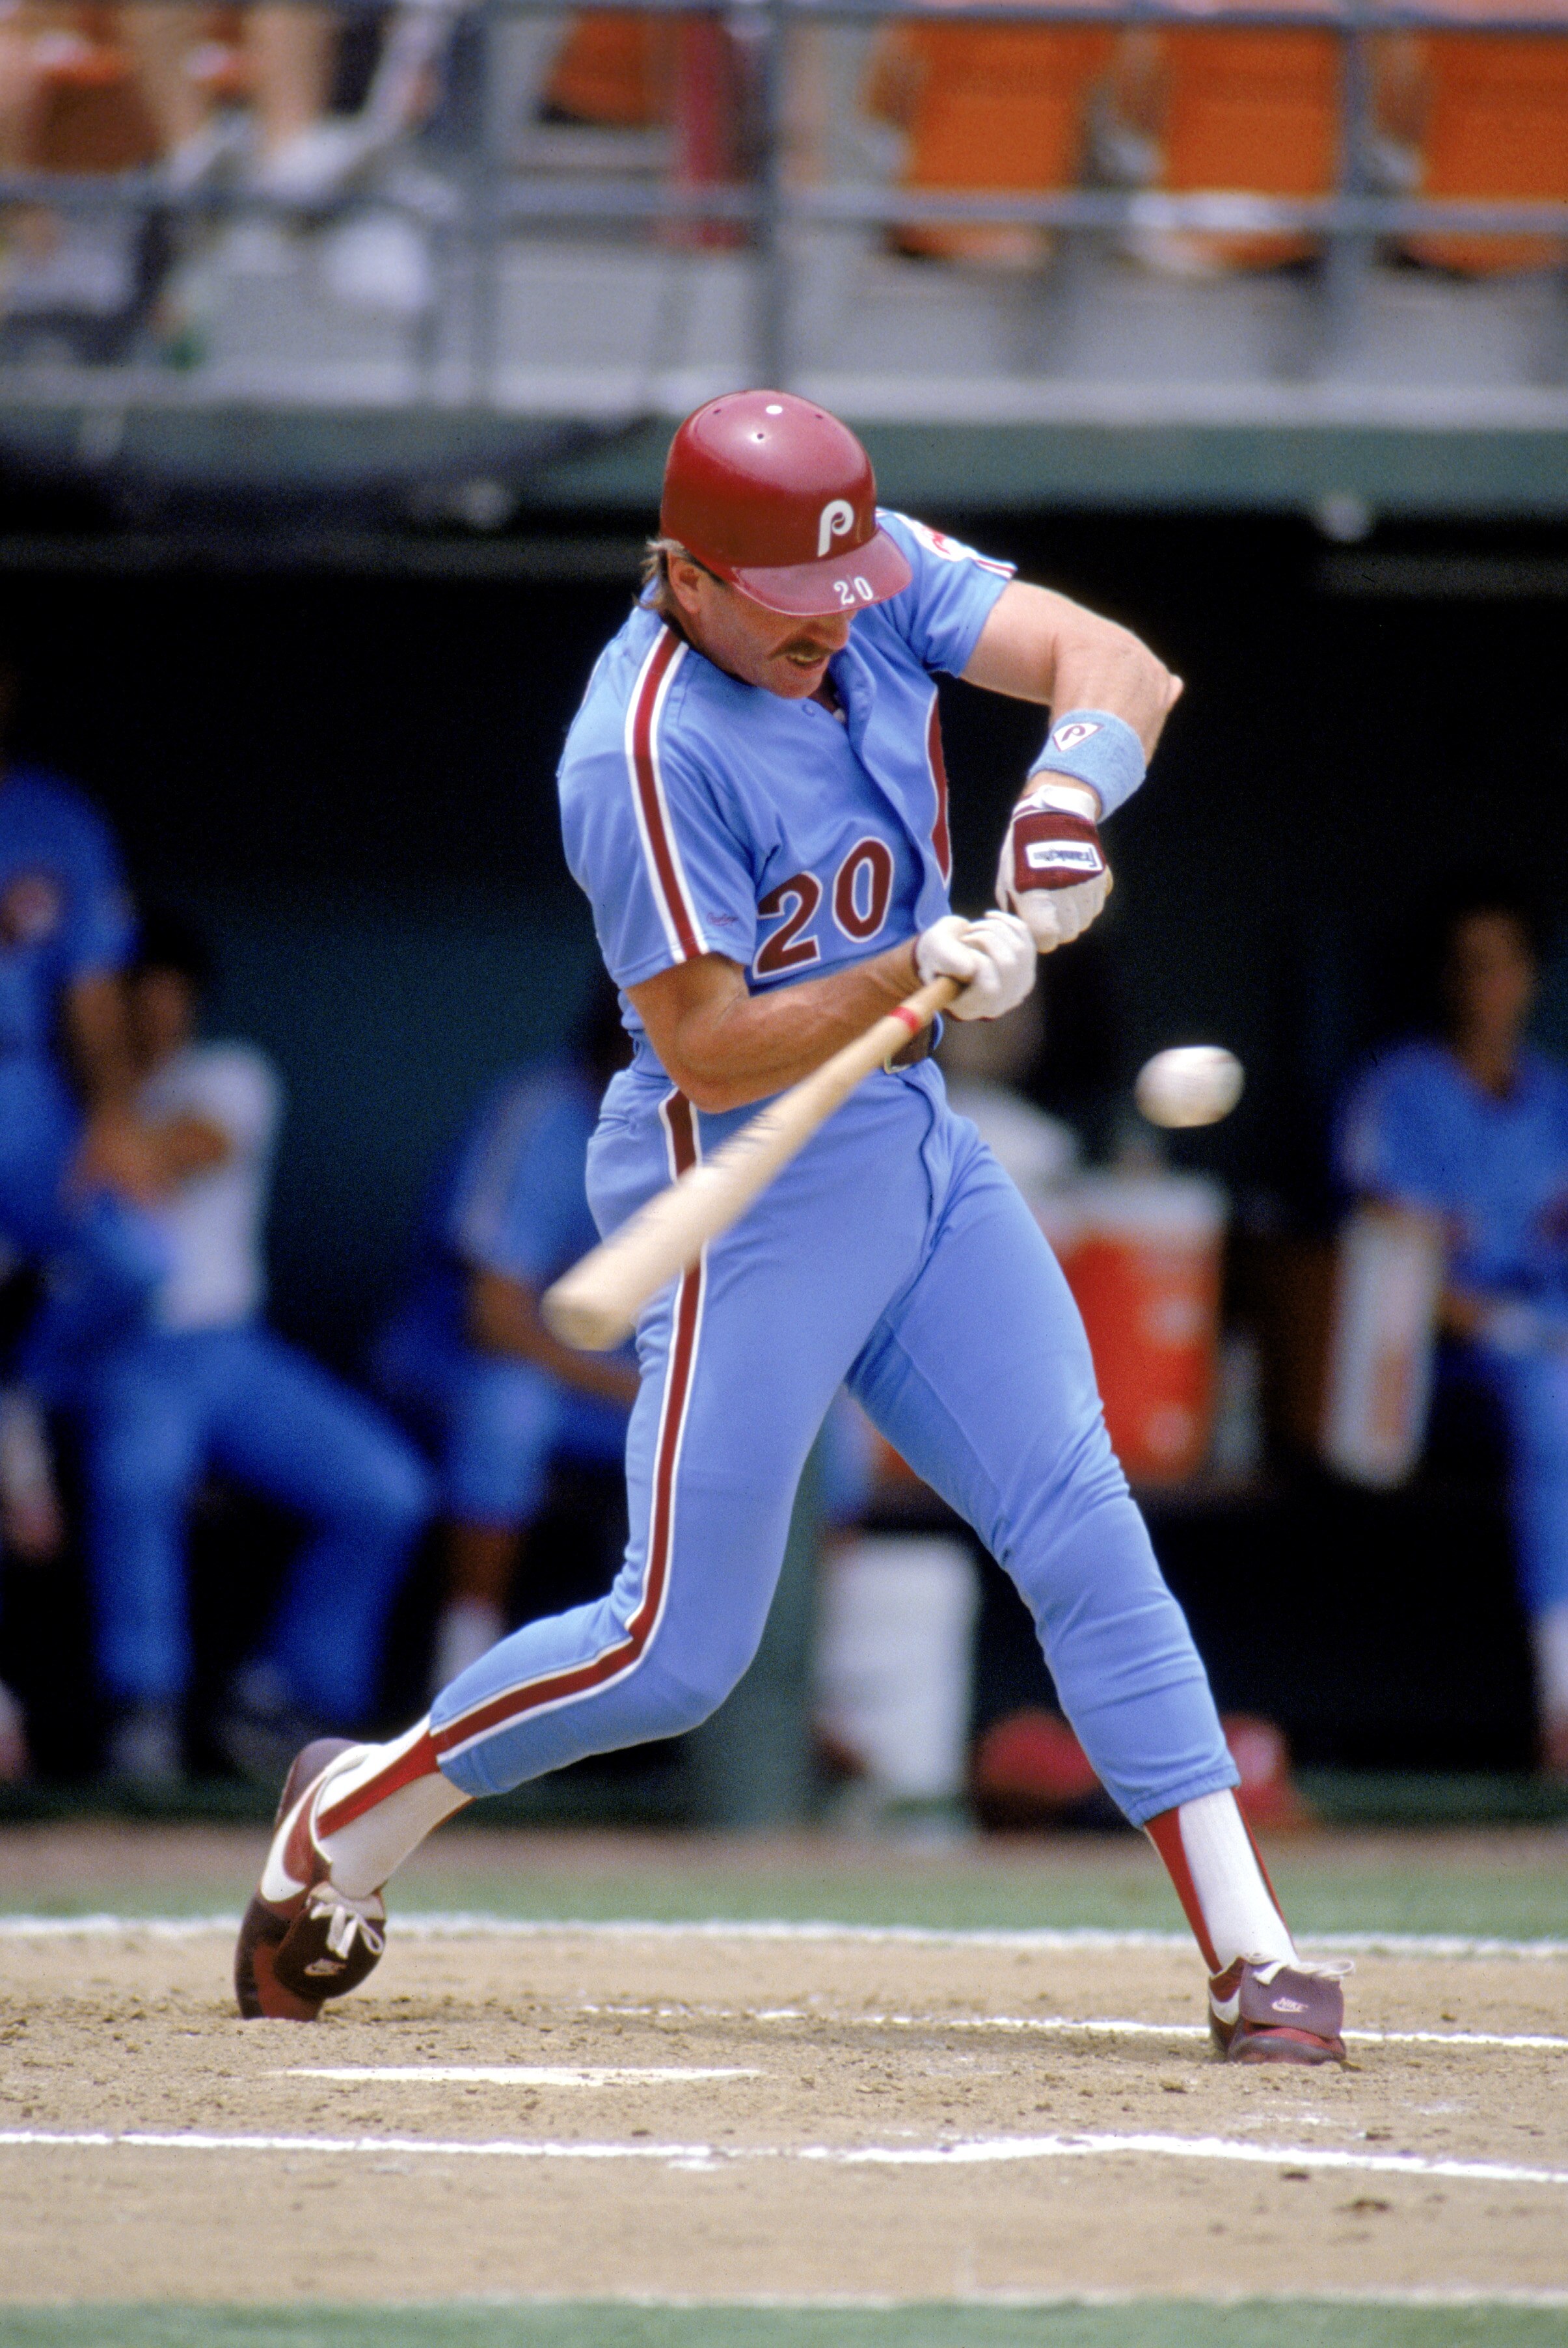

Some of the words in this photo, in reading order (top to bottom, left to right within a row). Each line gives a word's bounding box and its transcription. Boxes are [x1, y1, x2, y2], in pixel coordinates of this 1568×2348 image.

[817, 500, 854, 558] P
[833, 576, 874, 605] 20
[1033, 847, 1098, 867] Frank
[753, 836, 895, 979] 20
